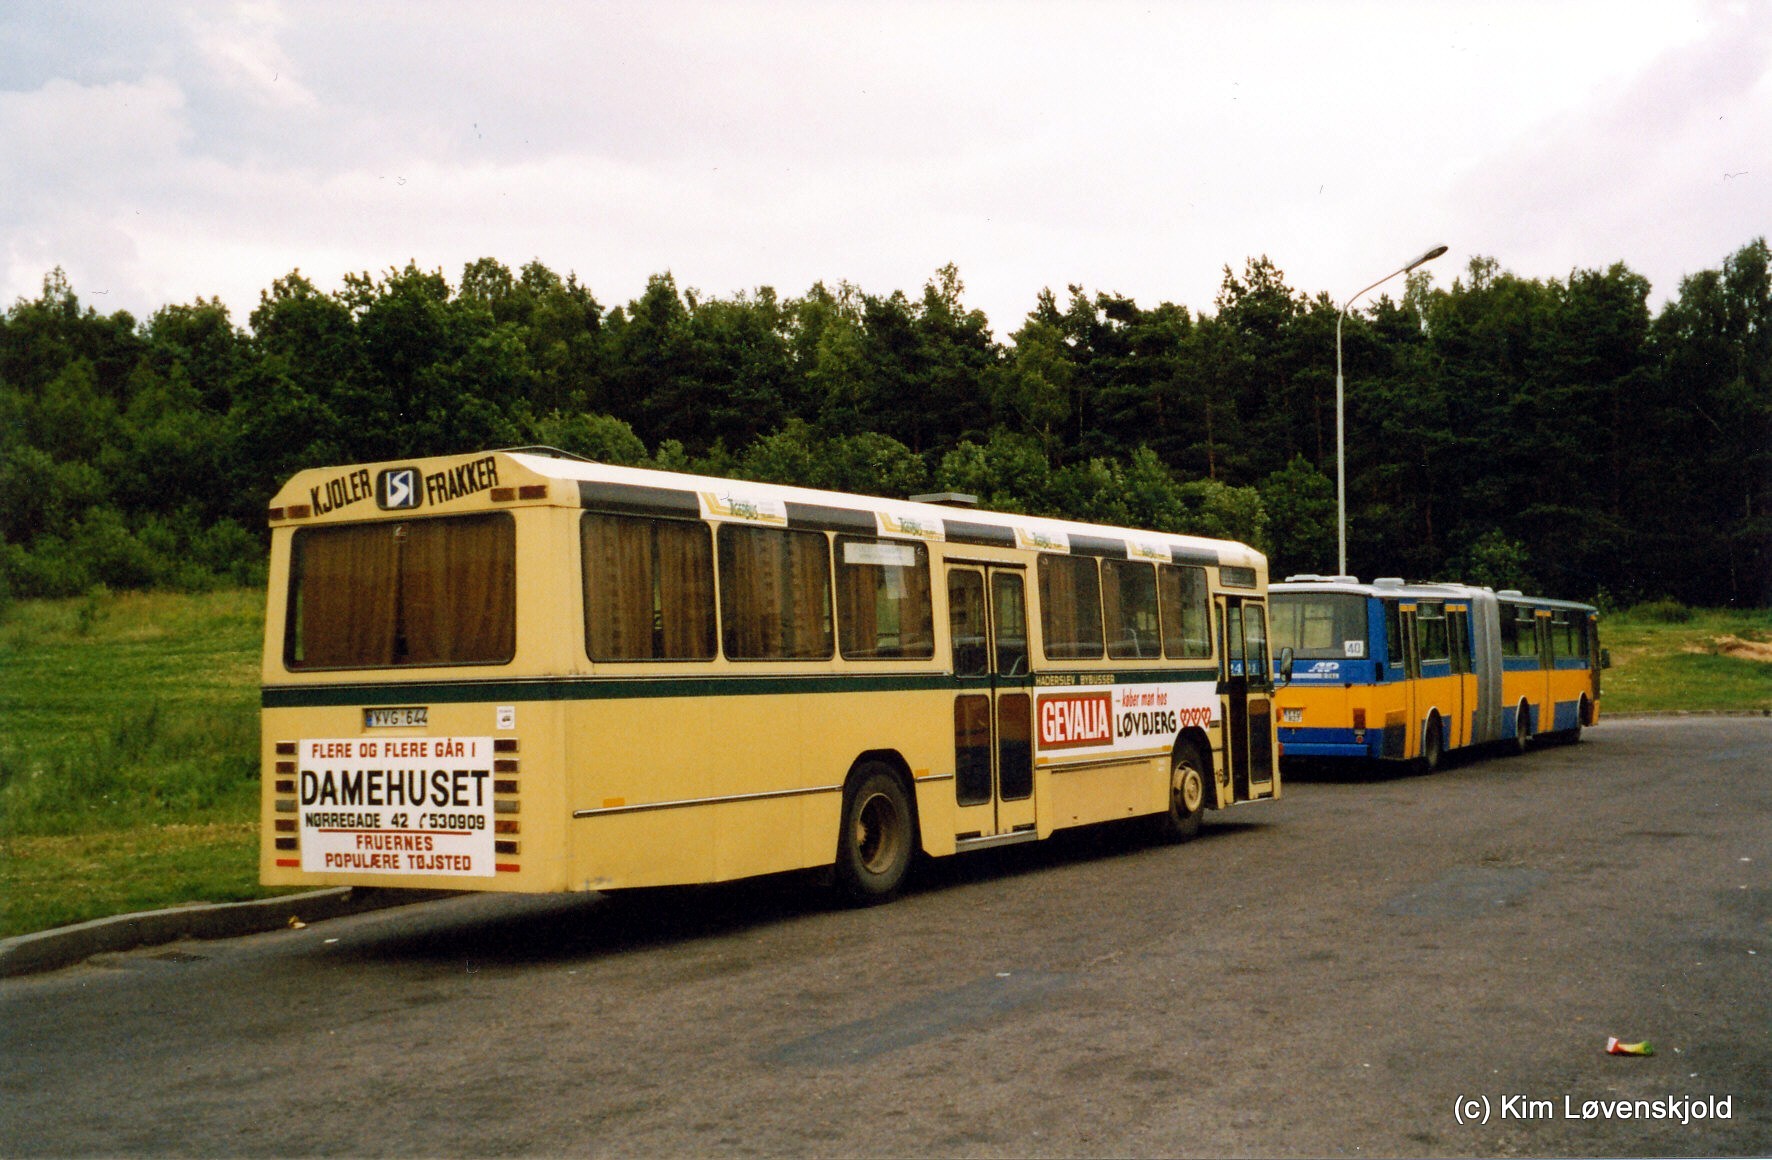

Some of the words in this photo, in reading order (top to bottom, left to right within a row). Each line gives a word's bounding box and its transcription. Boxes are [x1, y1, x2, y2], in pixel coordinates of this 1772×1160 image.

[425, 455, 499, 506] FRAKKER
[310, 468, 373, 517] KJOLER
[1035, 674, 1076, 686] HADERSLEV
[1080, 674, 1116, 685] BYBUSSER
[1141, 692, 1155, 706] man
[1156, 687, 1168, 706] hos
[406, 709, 428, 725] 644
[1042, 699, 1110, 743] GEVALIA
[1116, 710, 1177, 738] LØVBJERG
[311, 743, 352, 758] FLERE
[359, 743, 377, 758] OG
[385, 742, 428, 757] FLERE
[435, 738, 464, 758] GÅR
[471, 742, 476, 757] I
[300, 769, 490, 807] DAMEHUSET
[305, 812, 381, 828] NØRREGADE
[391, 813, 409, 828] 42
[429, 813, 486, 830] 530909
[356, 835, 434, 851] FRUERNES
[325, 853, 400, 869] POPULÆRE
[407, 855, 472, 871] TØJSTED
